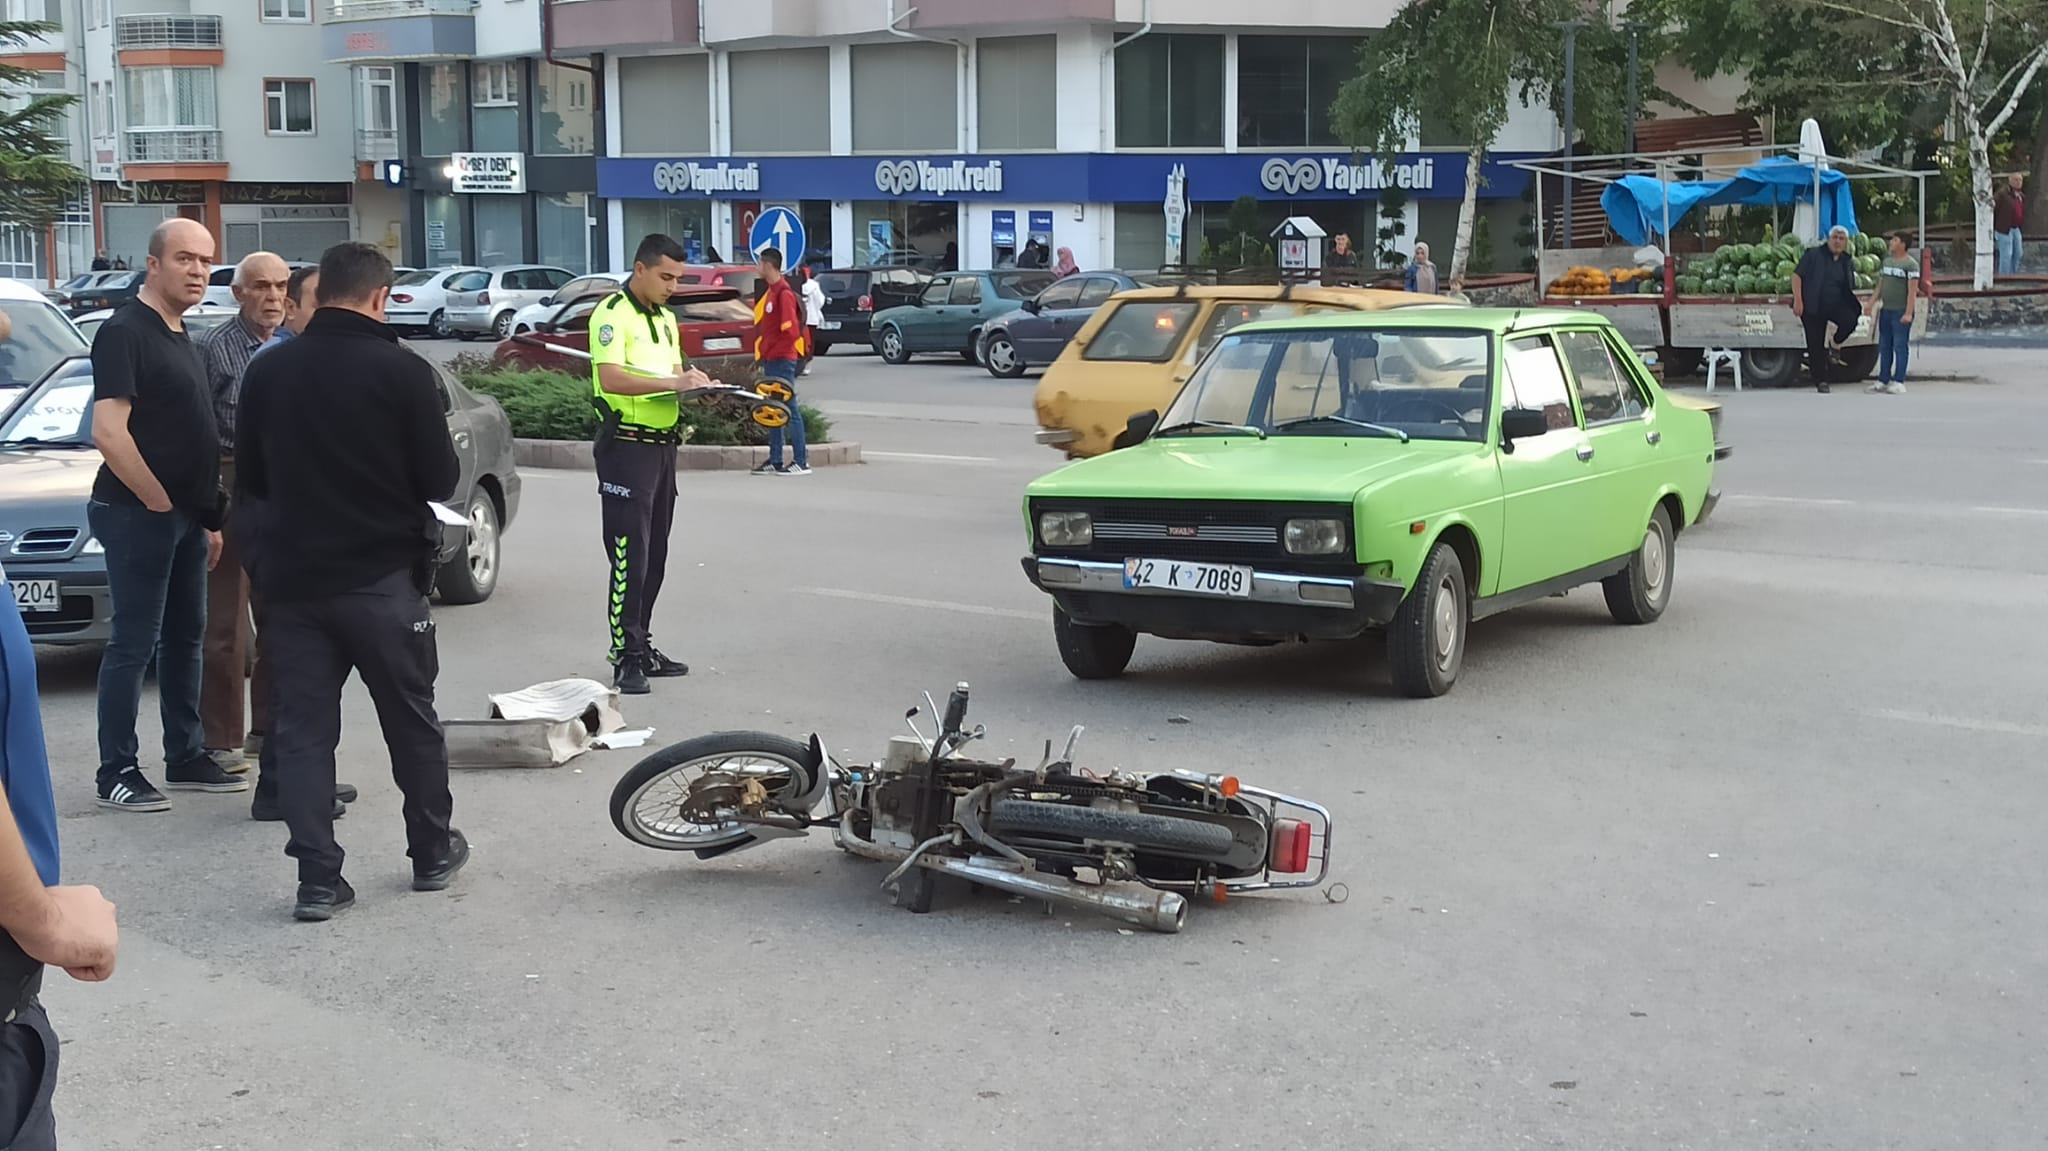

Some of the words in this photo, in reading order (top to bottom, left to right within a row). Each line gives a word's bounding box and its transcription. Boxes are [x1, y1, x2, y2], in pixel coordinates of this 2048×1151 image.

[917, 160, 1002, 196] YapıKredi
[136, 184, 175, 201] NAZ
[222, 185, 263, 201] NAZ
[1133, 559, 1155, 587] 42
[1168, 564, 1181, 587] K
[1195, 567, 1243, 592] 7089
